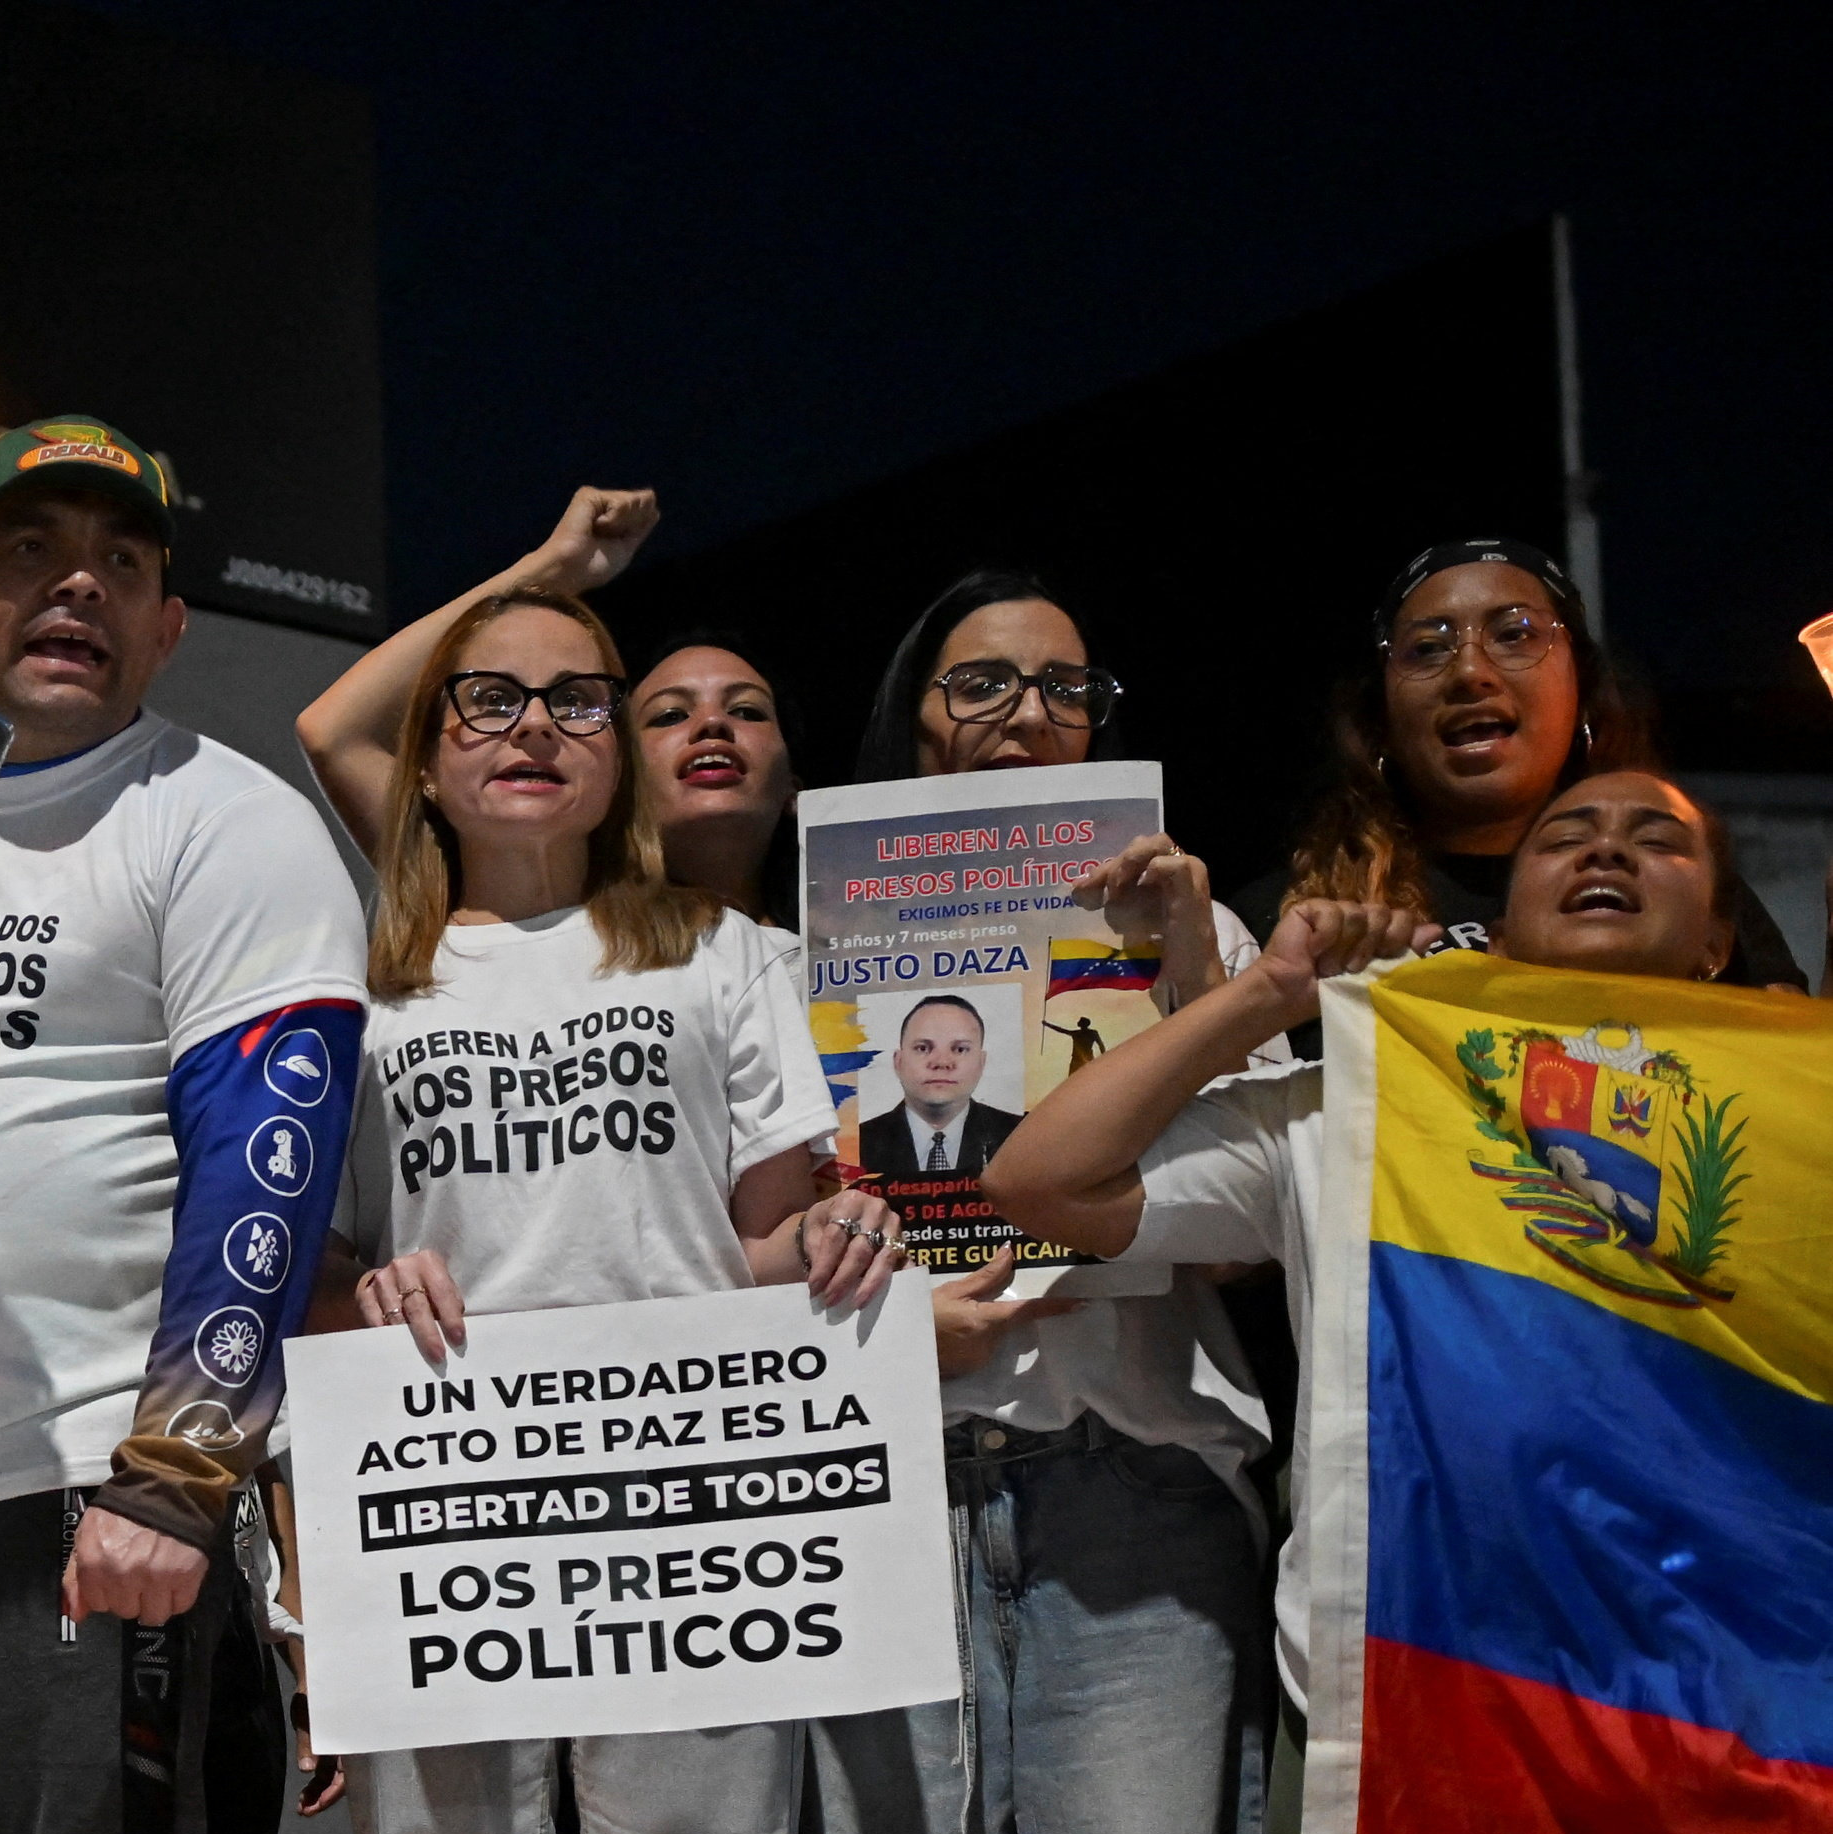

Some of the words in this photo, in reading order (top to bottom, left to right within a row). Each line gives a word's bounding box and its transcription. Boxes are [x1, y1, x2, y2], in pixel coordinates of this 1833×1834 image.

[38, 443, 126, 465] DEKALB
[877, 829, 997, 861] LIBEREN
[1006, 827, 1026, 850] A
[1037, 820, 1094, 847] LOS
[846, 871, 956, 902] PRESOS
[898, 903, 980, 923] EXIGIMOS
[985, 901, 1004, 916] FE
[1008, 899, 1028, 913] DE
[1034, 896, 1073, 912] VIDA
[828, 935, 837, 948] 5
[842, 932, 881, 948] años
[885, 934, 895, 948] y
[900, 931, 909, 943] 7
[914, 926, 966, 944] meses
[971, 923, 1017, 941] preso
[810, 953, 921, 995] JUSTO
[933, 945, 1030, 979] DAZA
[382, 1029, 518, 1085] LIBEREN
[529, 1028, 551, 1058] A
[560, 1005, 676, 1045] TODOS
[393, 1067, 472, 1130] LOS
[489, 1041, 670, 1110] PRESOS
[398, 1100, 677, 1194] POLÍTICOS
[888, 1178, 980, 1197] desaparic
[906, 1205, 915, 1220] 5
[922, 1204, 945, 1219] DE
[948, 1227, 969, 1240] su
[402, 1379, 476, 1418] UN
[490, 1346, 827, 1408] VERDADERO
[356, 1428, 497, 1476] ACTO
[515, 1422, 585, 1458] DE
[603, 1410, 706, 1453] PAZ
[724, 1401, 785, 1441] ES
[804, 1395, 870, 1432] LA
[367, 1483, 610, 1539] LIBERTAD
[625, 1477, 695, 1516] DE
[713, 1458, 884, 1509] TODOS
[398, 1562, 535, 1618] LOS
[559, 1536, 844, 1604] PRESOS
[408, 1603, 843, 1688] POLÍTICOS
